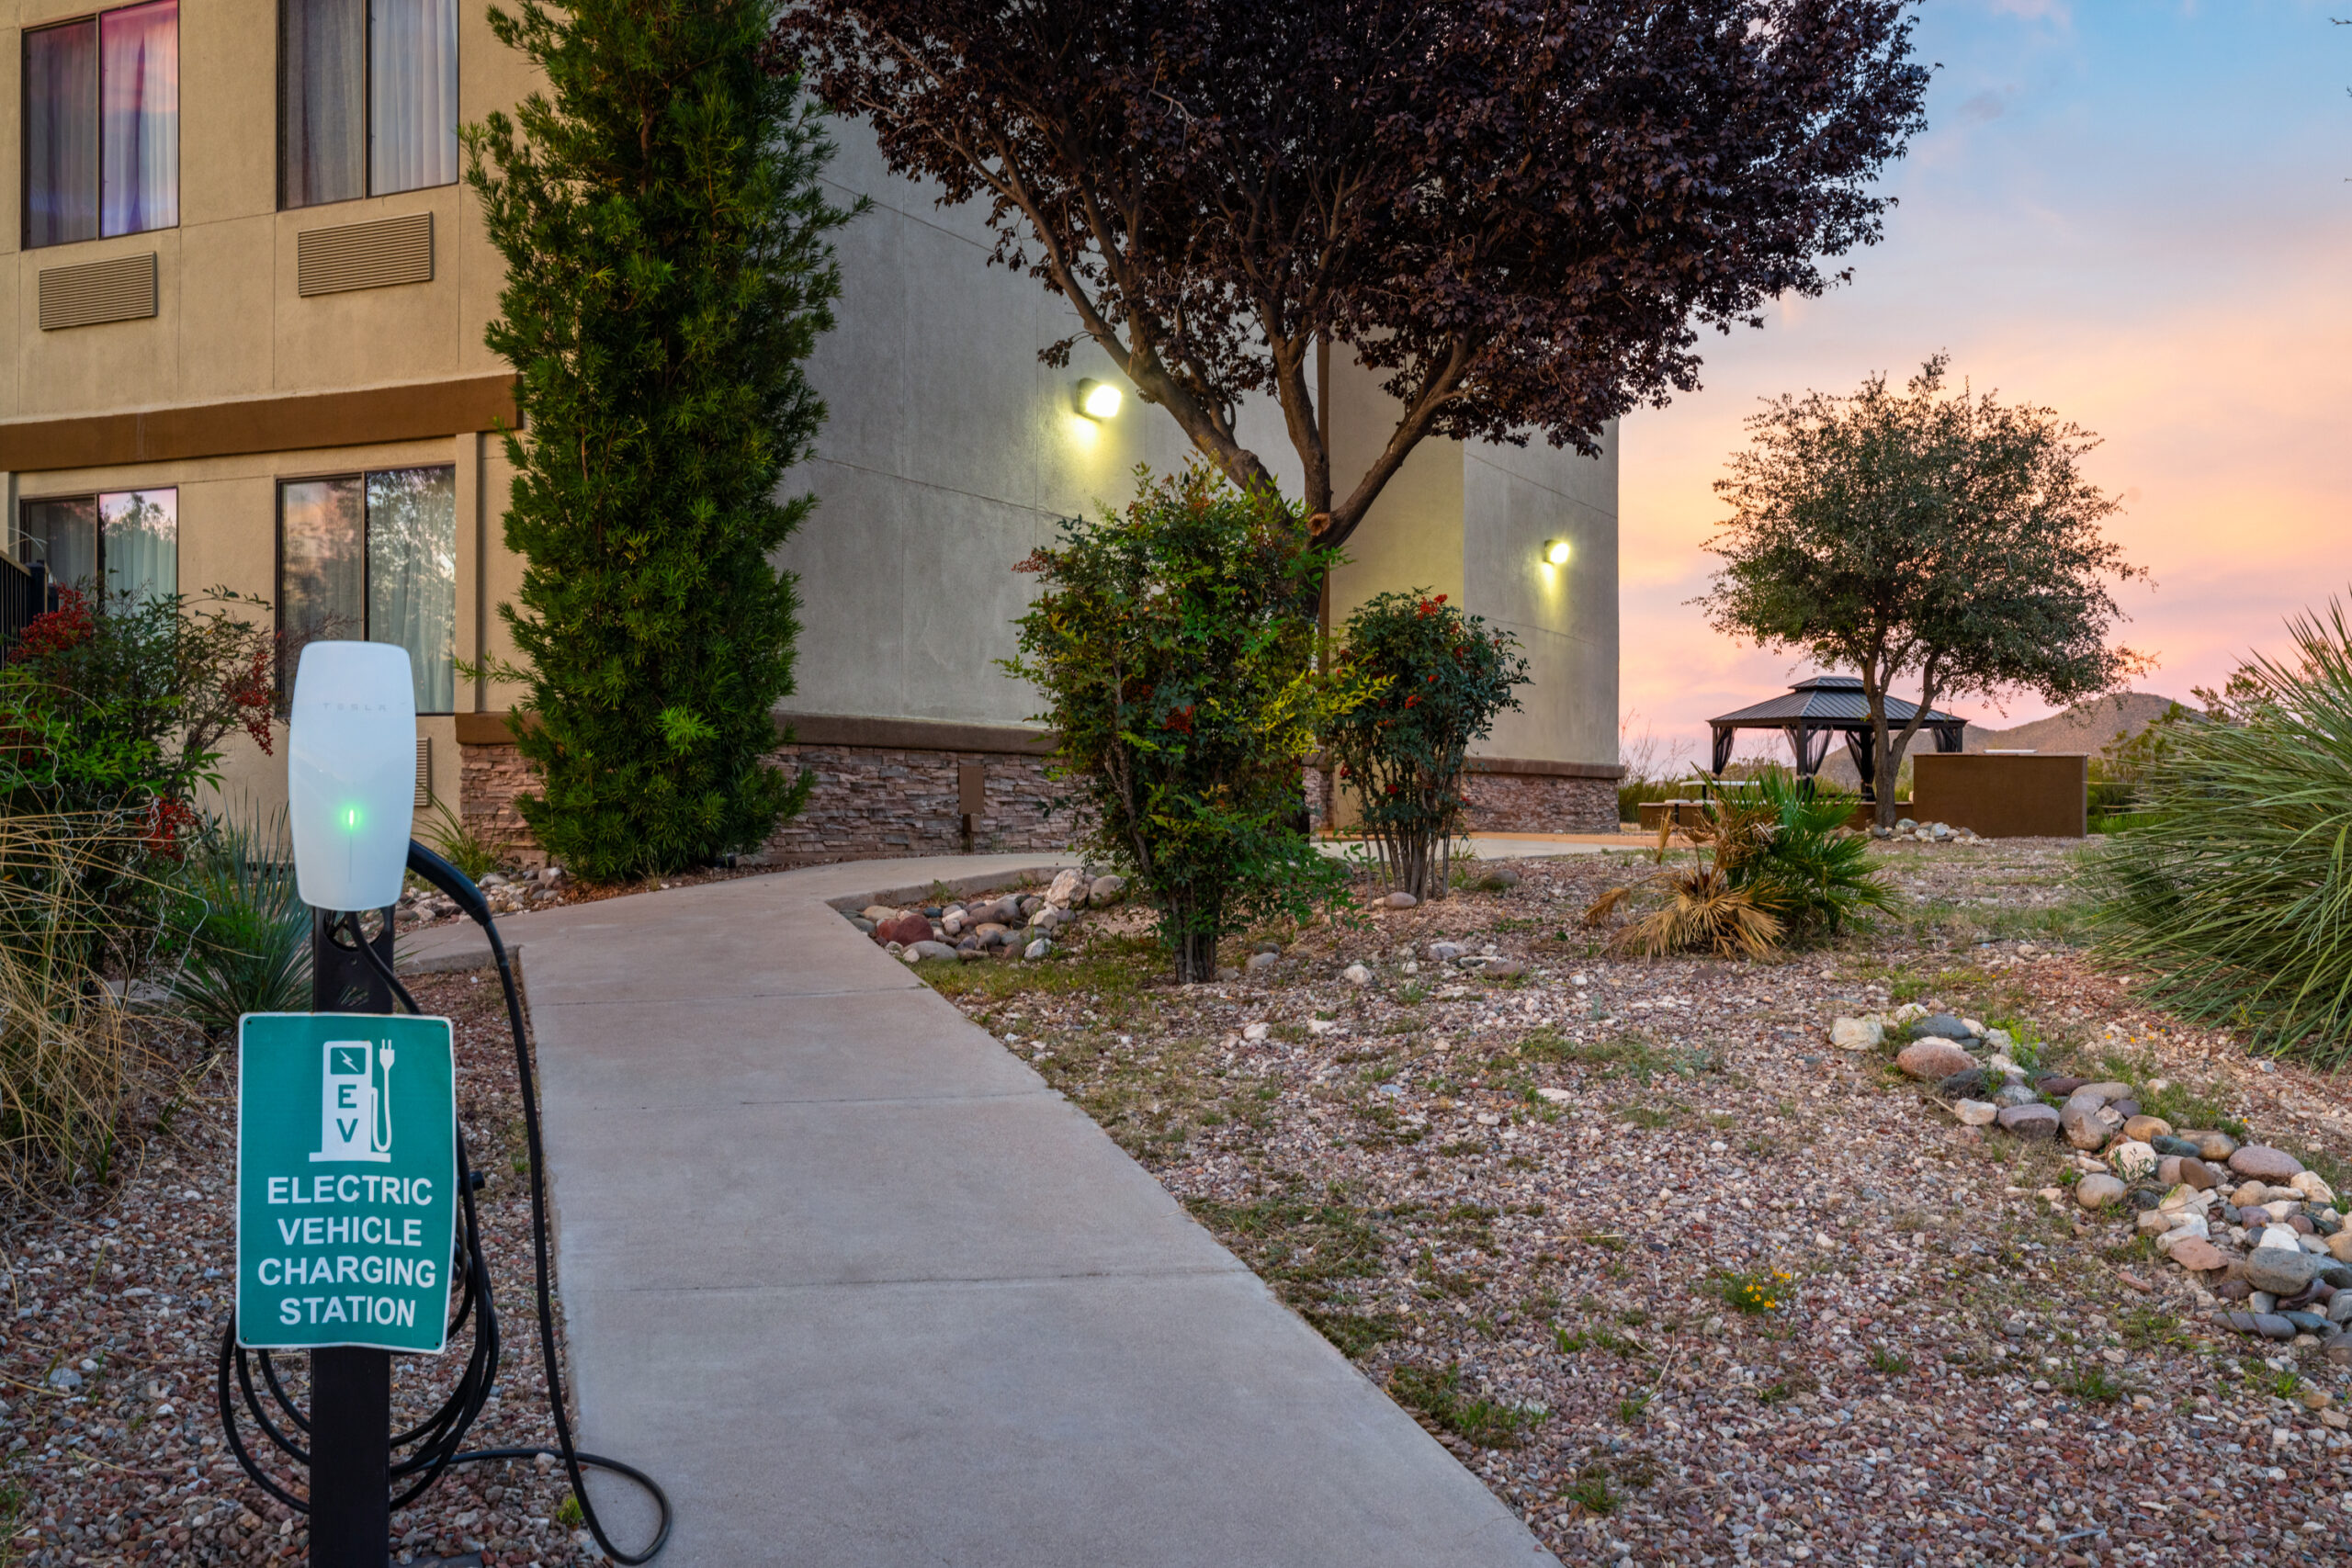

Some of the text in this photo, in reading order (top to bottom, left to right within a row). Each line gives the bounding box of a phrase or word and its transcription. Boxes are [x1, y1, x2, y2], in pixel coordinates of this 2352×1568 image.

[267, 1175, 433, 1205] ELECTRIC
[277, 1216, 422, 1247] VEHICLE
[258, 1256, 436, 1288] CHARGING
[279, 1295, 416, 1327] STATION
